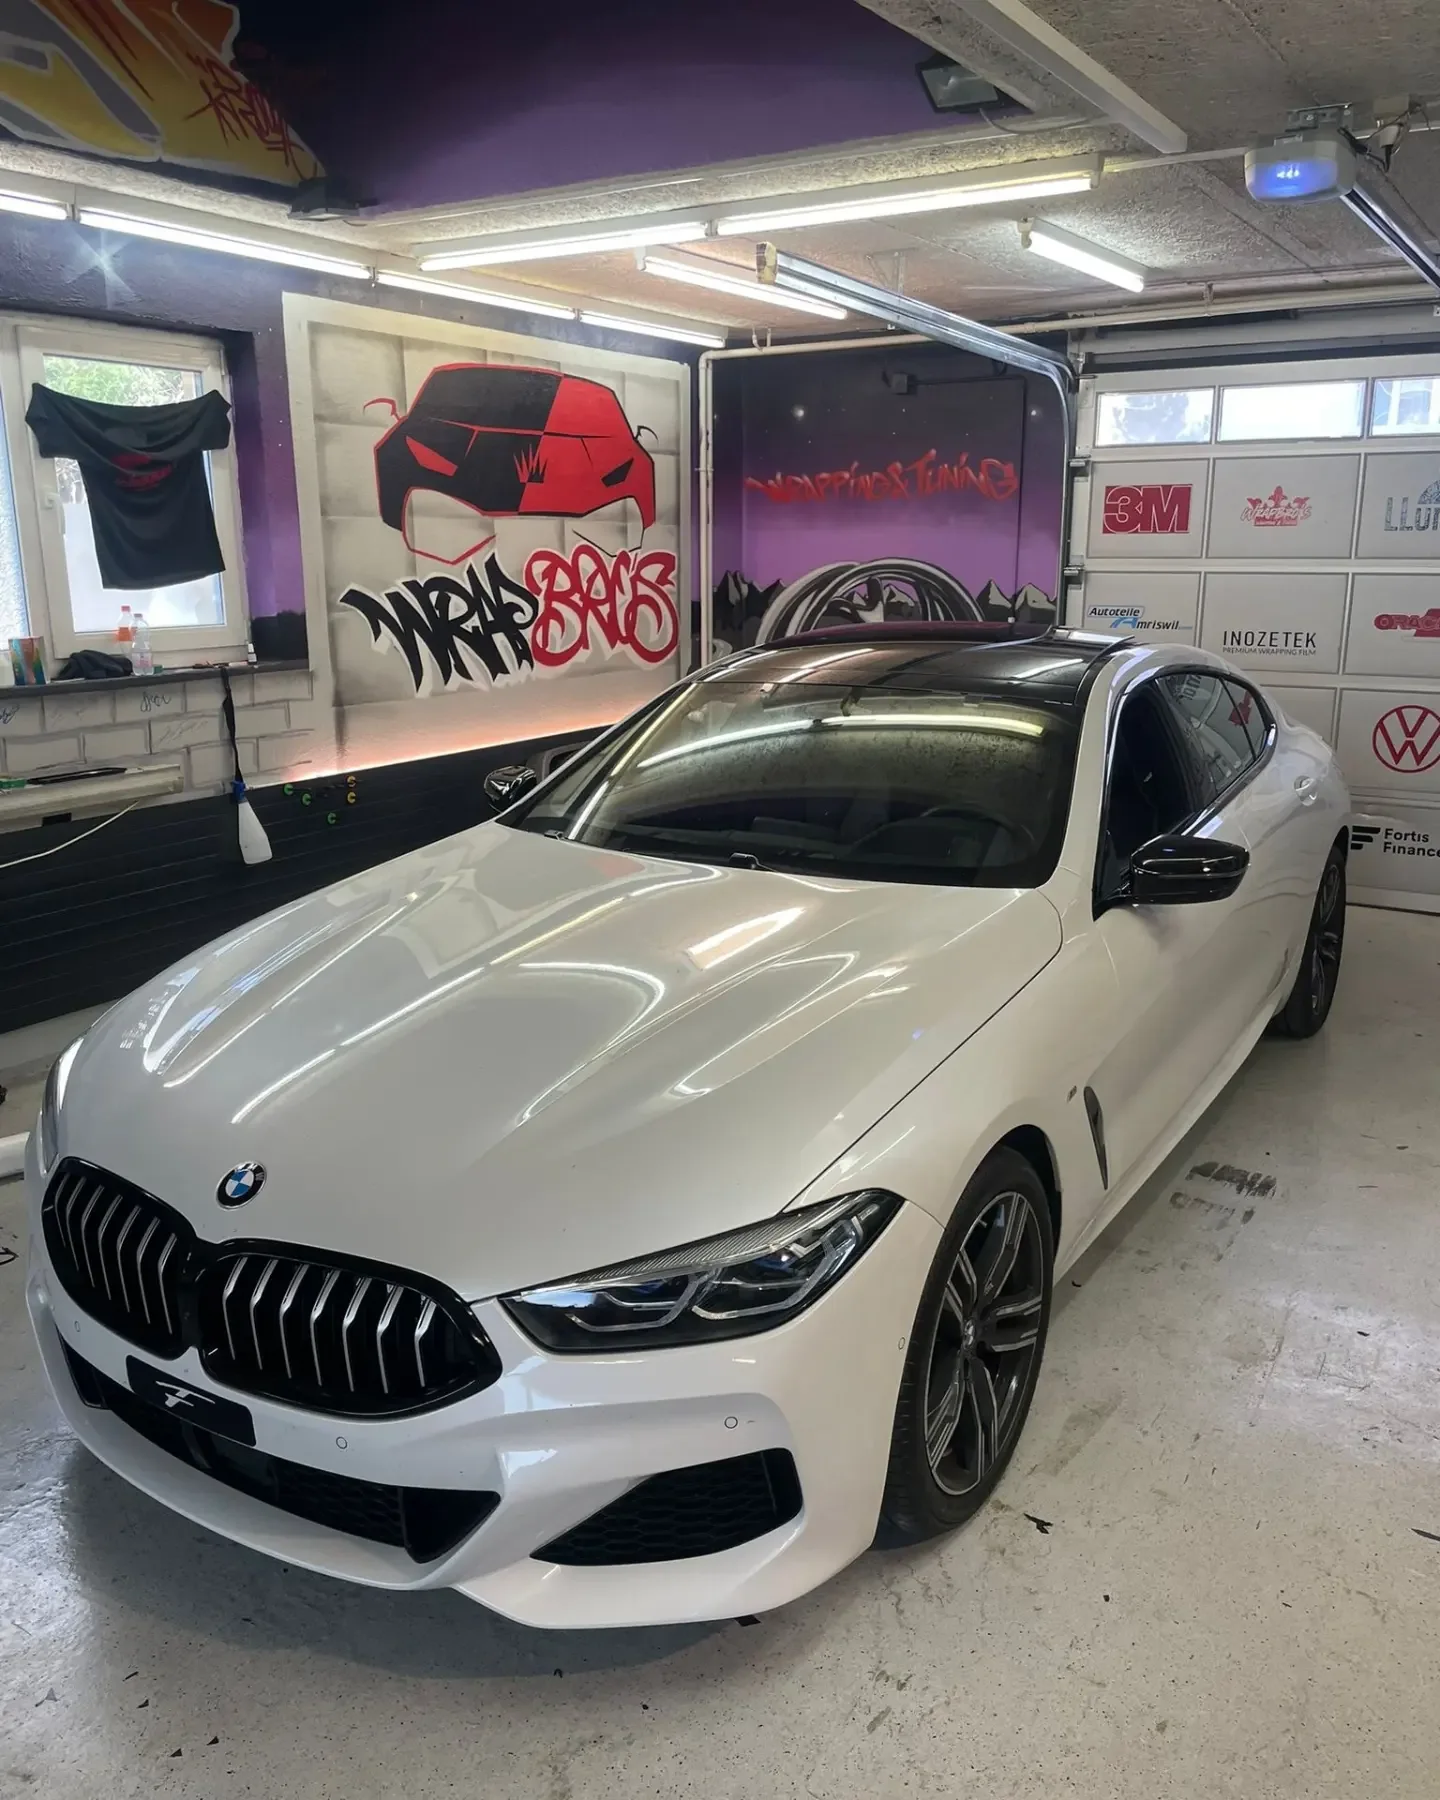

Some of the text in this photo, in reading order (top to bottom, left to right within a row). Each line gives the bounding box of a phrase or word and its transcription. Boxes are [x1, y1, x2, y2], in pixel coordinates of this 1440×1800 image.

[1103, 484, 1193, 534] 3M
[1089, 607, 1140, 617] Autoteile
[339, 553, 540, 693] WRAP
[1110, 617, 1179, 630] Amriswil
[1375, 613, 1440, 631] ORAC
[1223, 631, 1316, 648] INOZETEK
[1258, 648, 1297, 656] WRAPPING
[1384, 828, 1429, 843] Fortis
